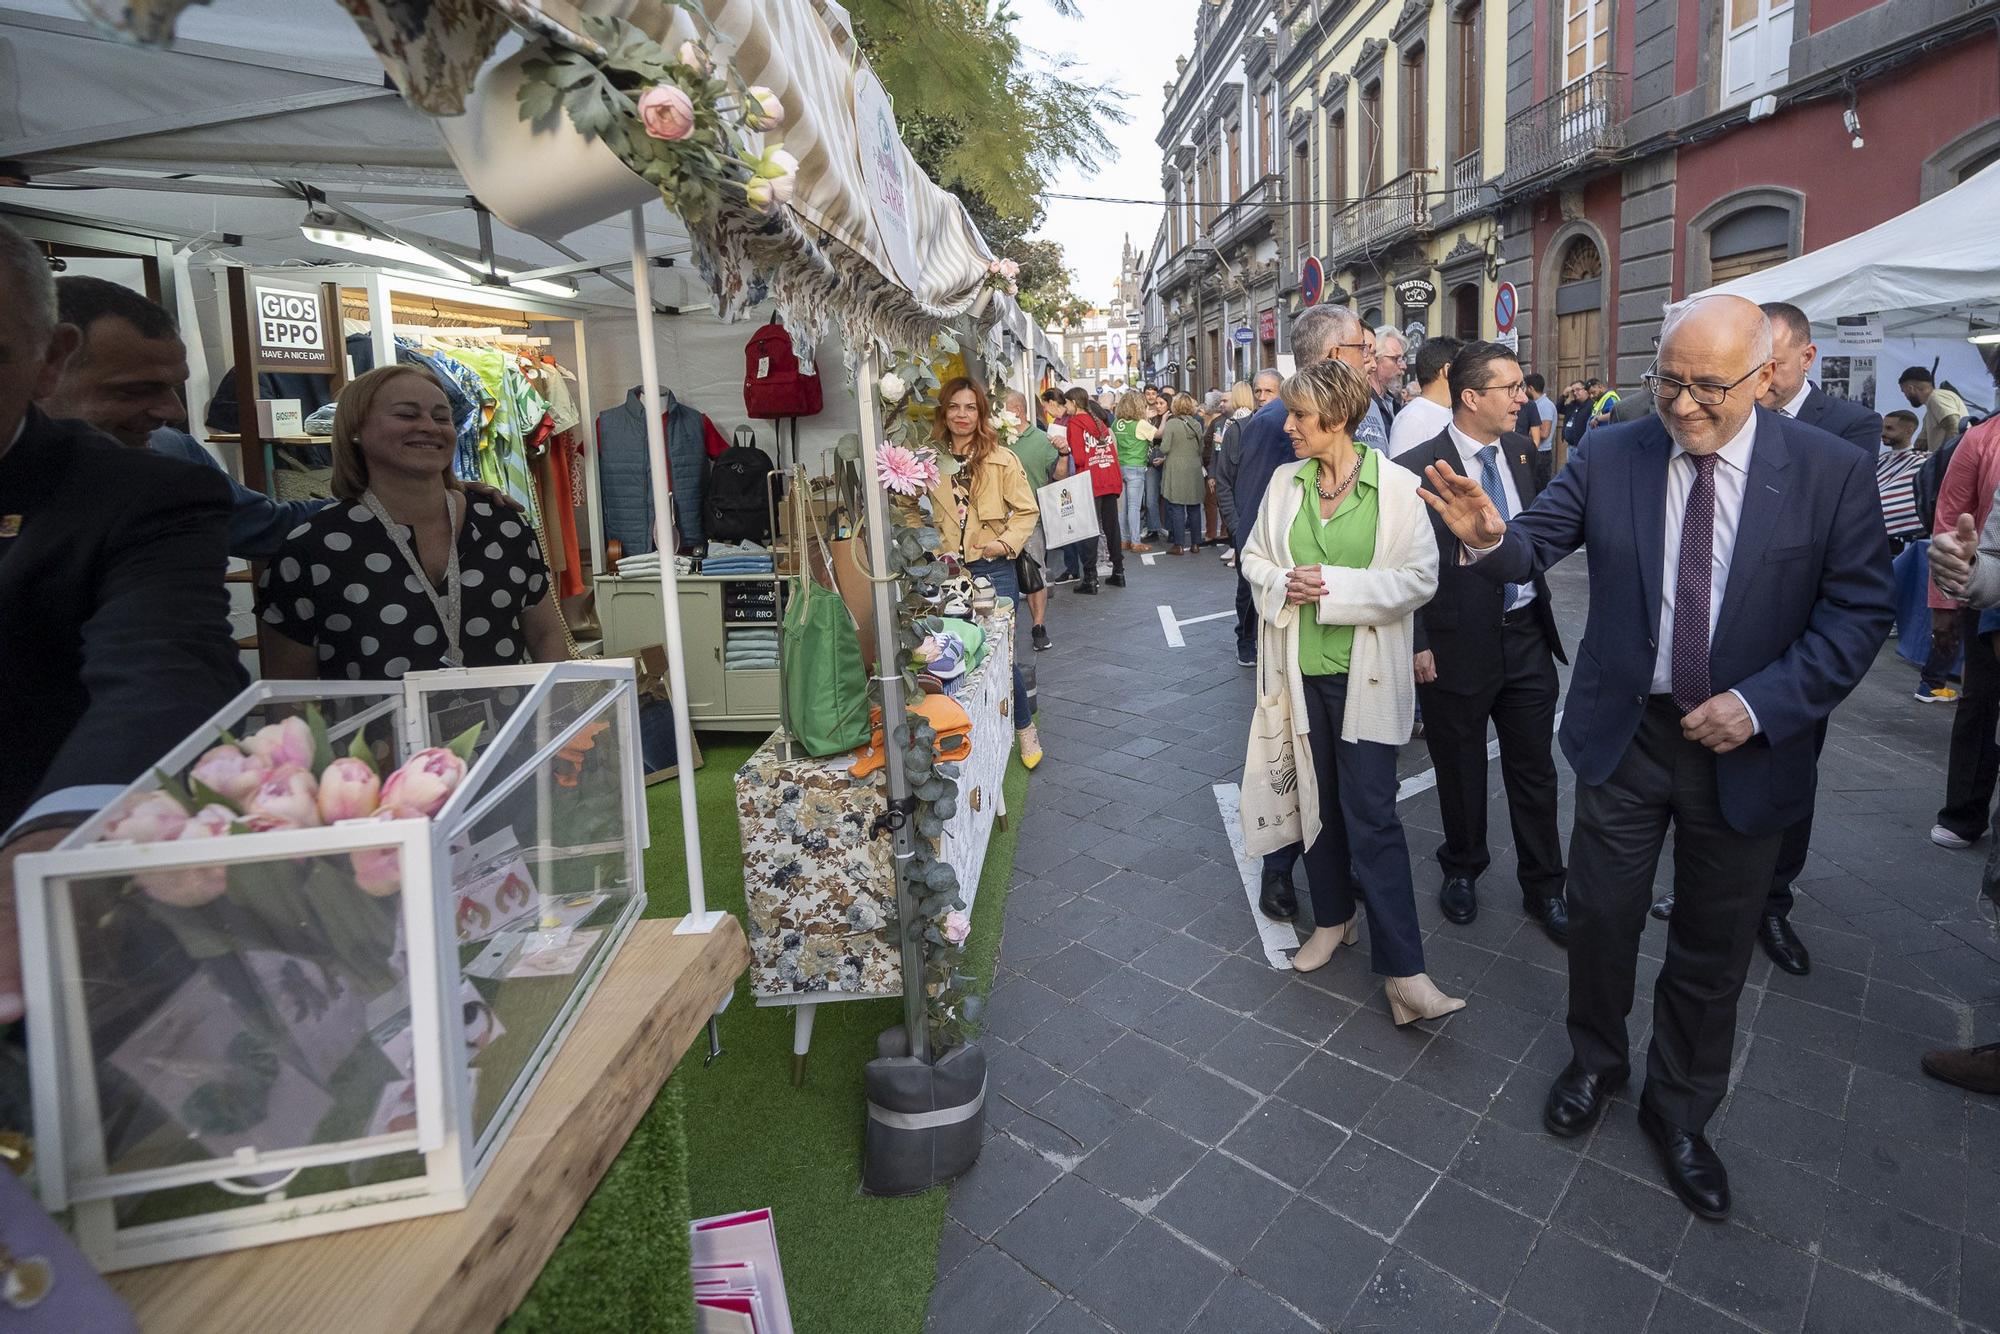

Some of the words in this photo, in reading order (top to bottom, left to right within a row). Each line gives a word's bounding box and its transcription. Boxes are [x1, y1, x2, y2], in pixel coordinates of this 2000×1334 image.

[1399, 280, 1433, 291] MESTIZOS
[262, 295, 315, 320] GIOS
[264, 321, 318, 345] EPPO
[261, 350, 283, 359] HAVE
[284, 351, 290, 359] A
[291, 351, 308, 360] NICE
[309, 352, 325, 361] DAY!
